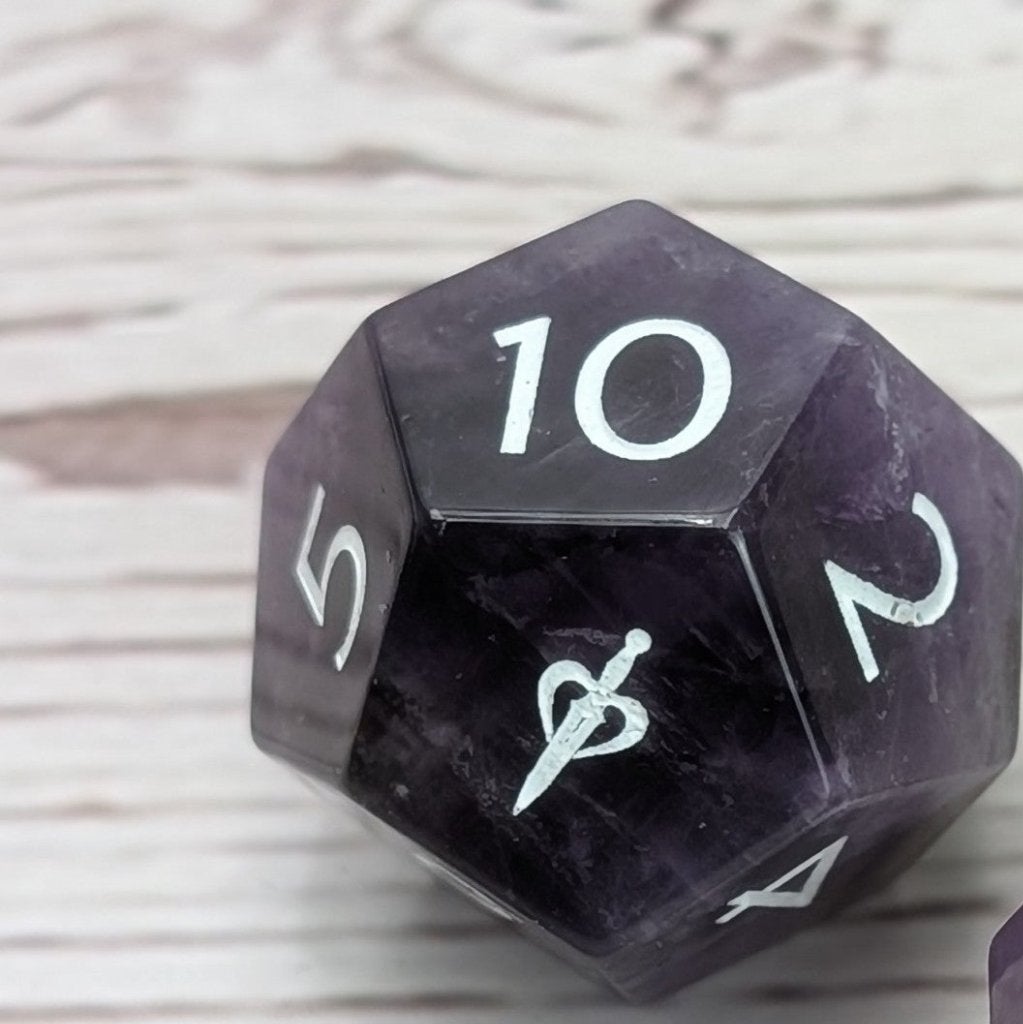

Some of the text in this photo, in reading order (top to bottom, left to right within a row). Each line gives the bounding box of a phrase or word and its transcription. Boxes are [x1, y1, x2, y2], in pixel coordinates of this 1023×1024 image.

[492, 315, 732, 461] 10
[294, 484, 367, 671] 5
[824, 492, 959, 683] 2
[715, 835, 849, 924] 4
